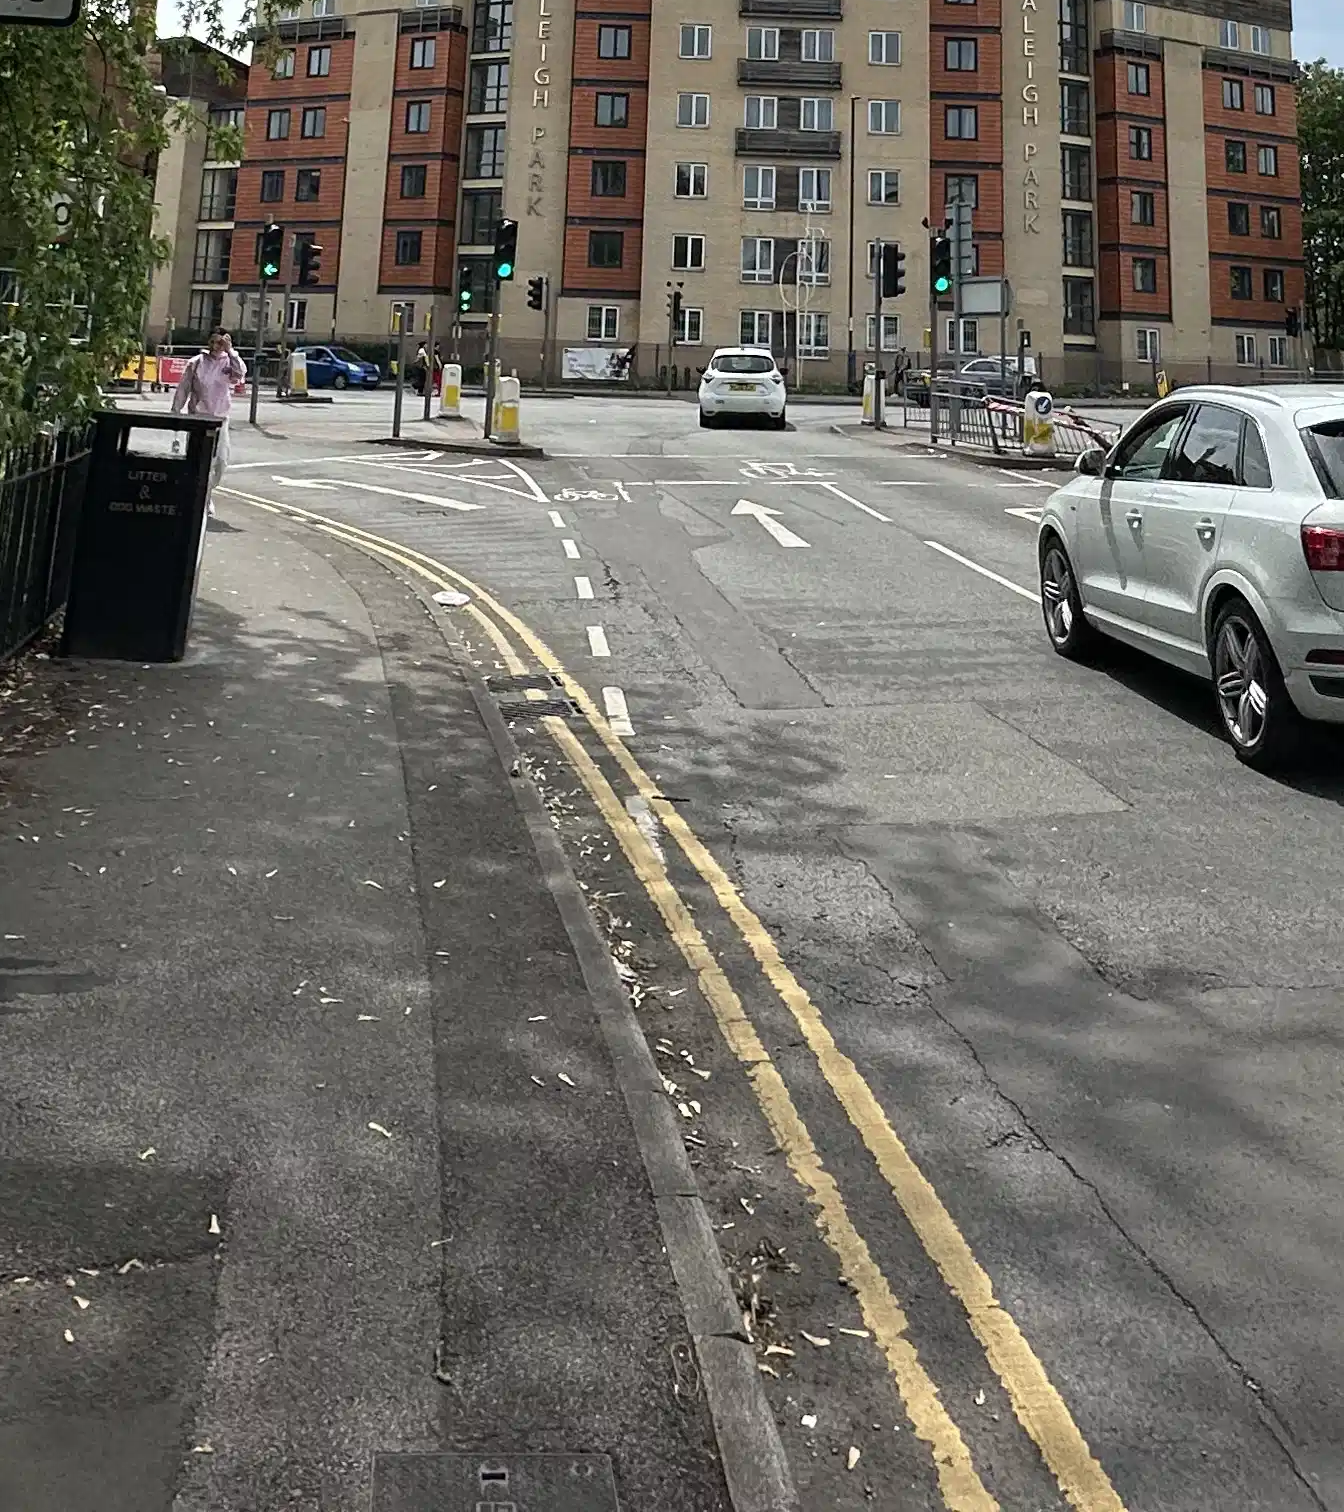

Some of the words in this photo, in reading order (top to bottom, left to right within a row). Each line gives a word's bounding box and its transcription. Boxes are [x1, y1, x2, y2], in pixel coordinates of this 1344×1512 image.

[527, 125, 546, 218] PARK
[1023, 143, 1040, 234] PARK
[127, 470, 168, 482] LITTER
